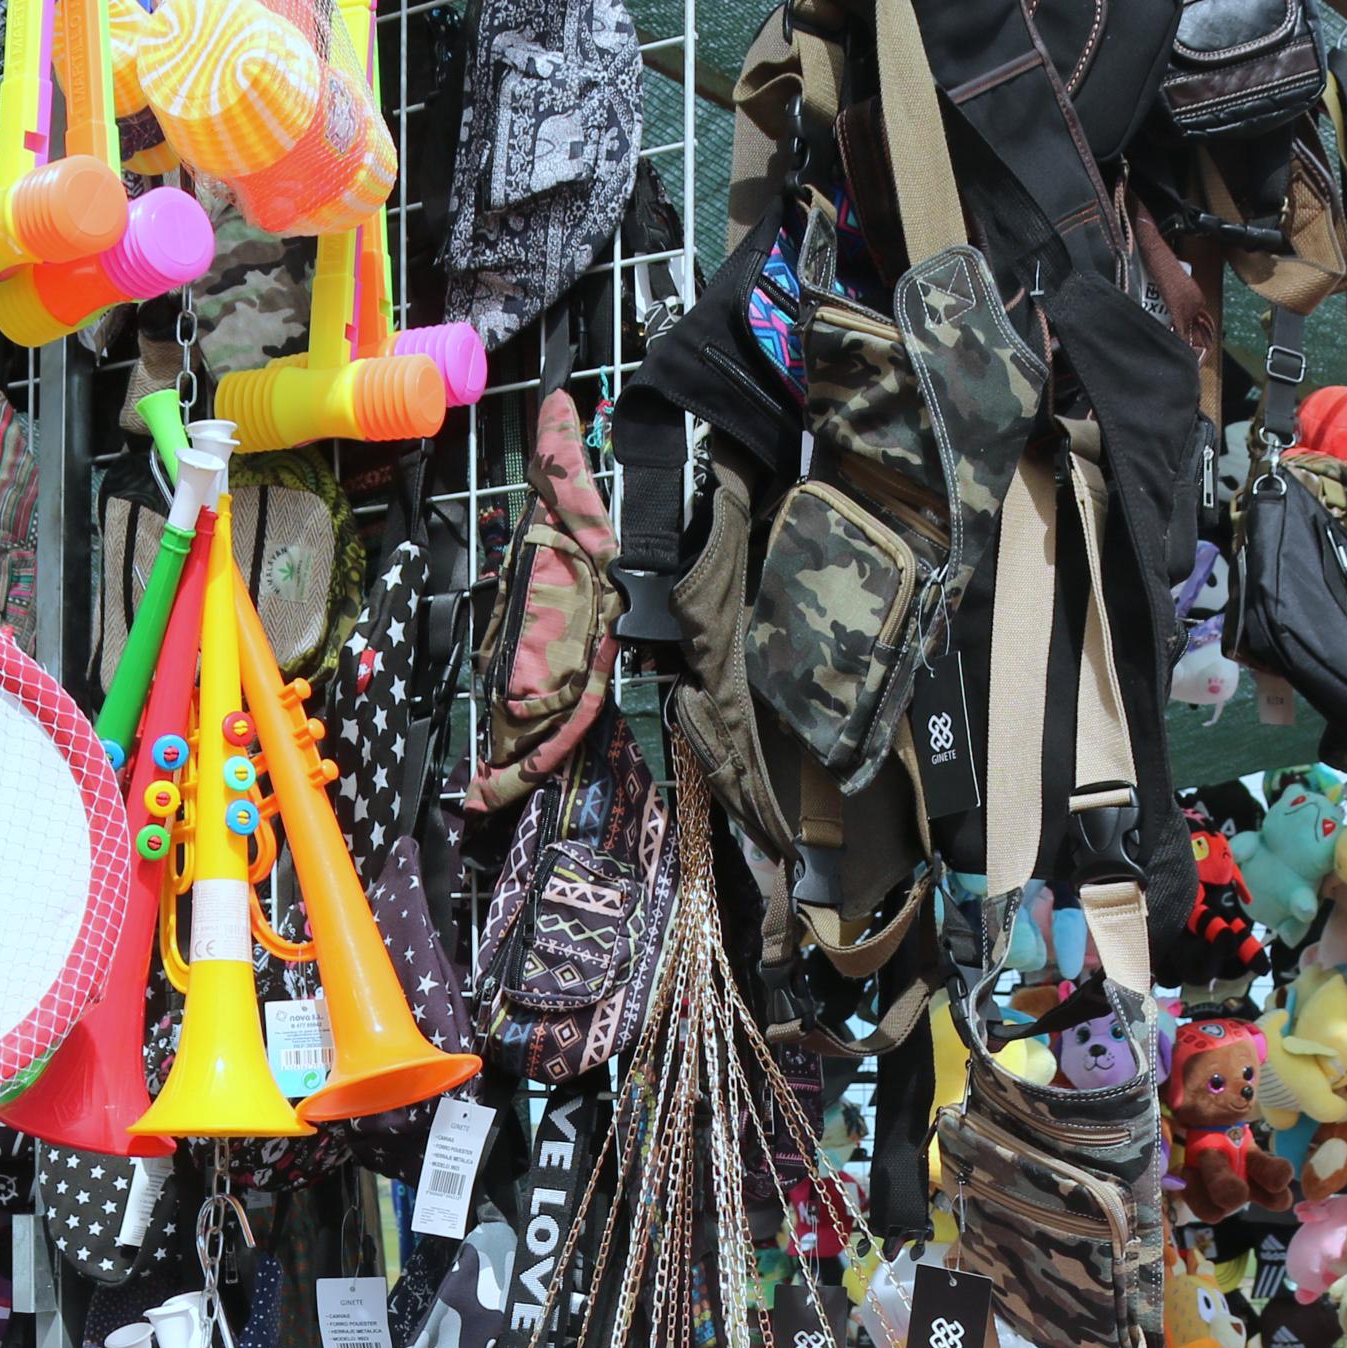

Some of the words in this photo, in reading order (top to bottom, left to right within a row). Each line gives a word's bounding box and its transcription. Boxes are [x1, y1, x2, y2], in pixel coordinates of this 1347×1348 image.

[931, 749, 957, 765] GINETE
[451, 1123, 470, 1131] GINETE
[510, 1187, 566, 1331] LOVE
